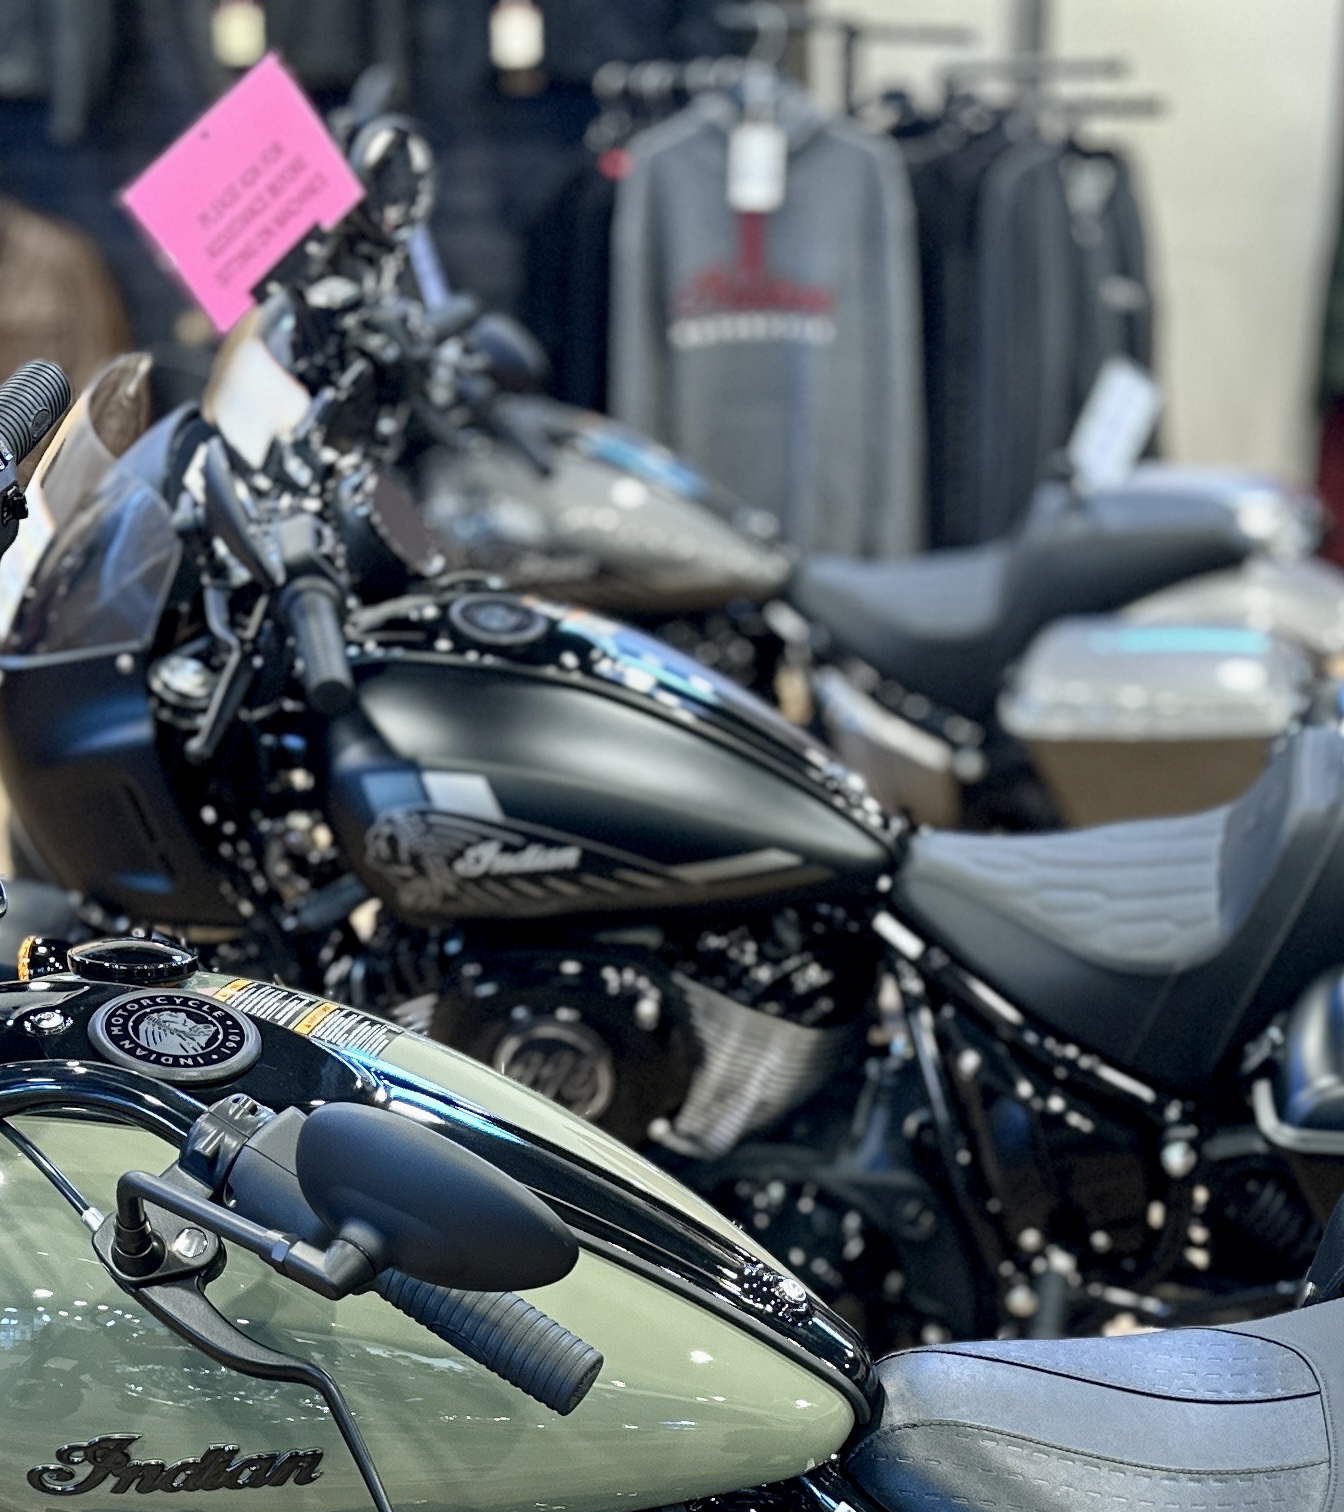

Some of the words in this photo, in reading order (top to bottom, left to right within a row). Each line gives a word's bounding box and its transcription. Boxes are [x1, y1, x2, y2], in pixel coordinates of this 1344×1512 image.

[111, 996, 225, 1035] MOTORCYCLE
[120, 1040, 205, 1066] INDIAN
[221, 1029, 241, 1054] 1901
[26, 1432, 324, 1496] Indian
